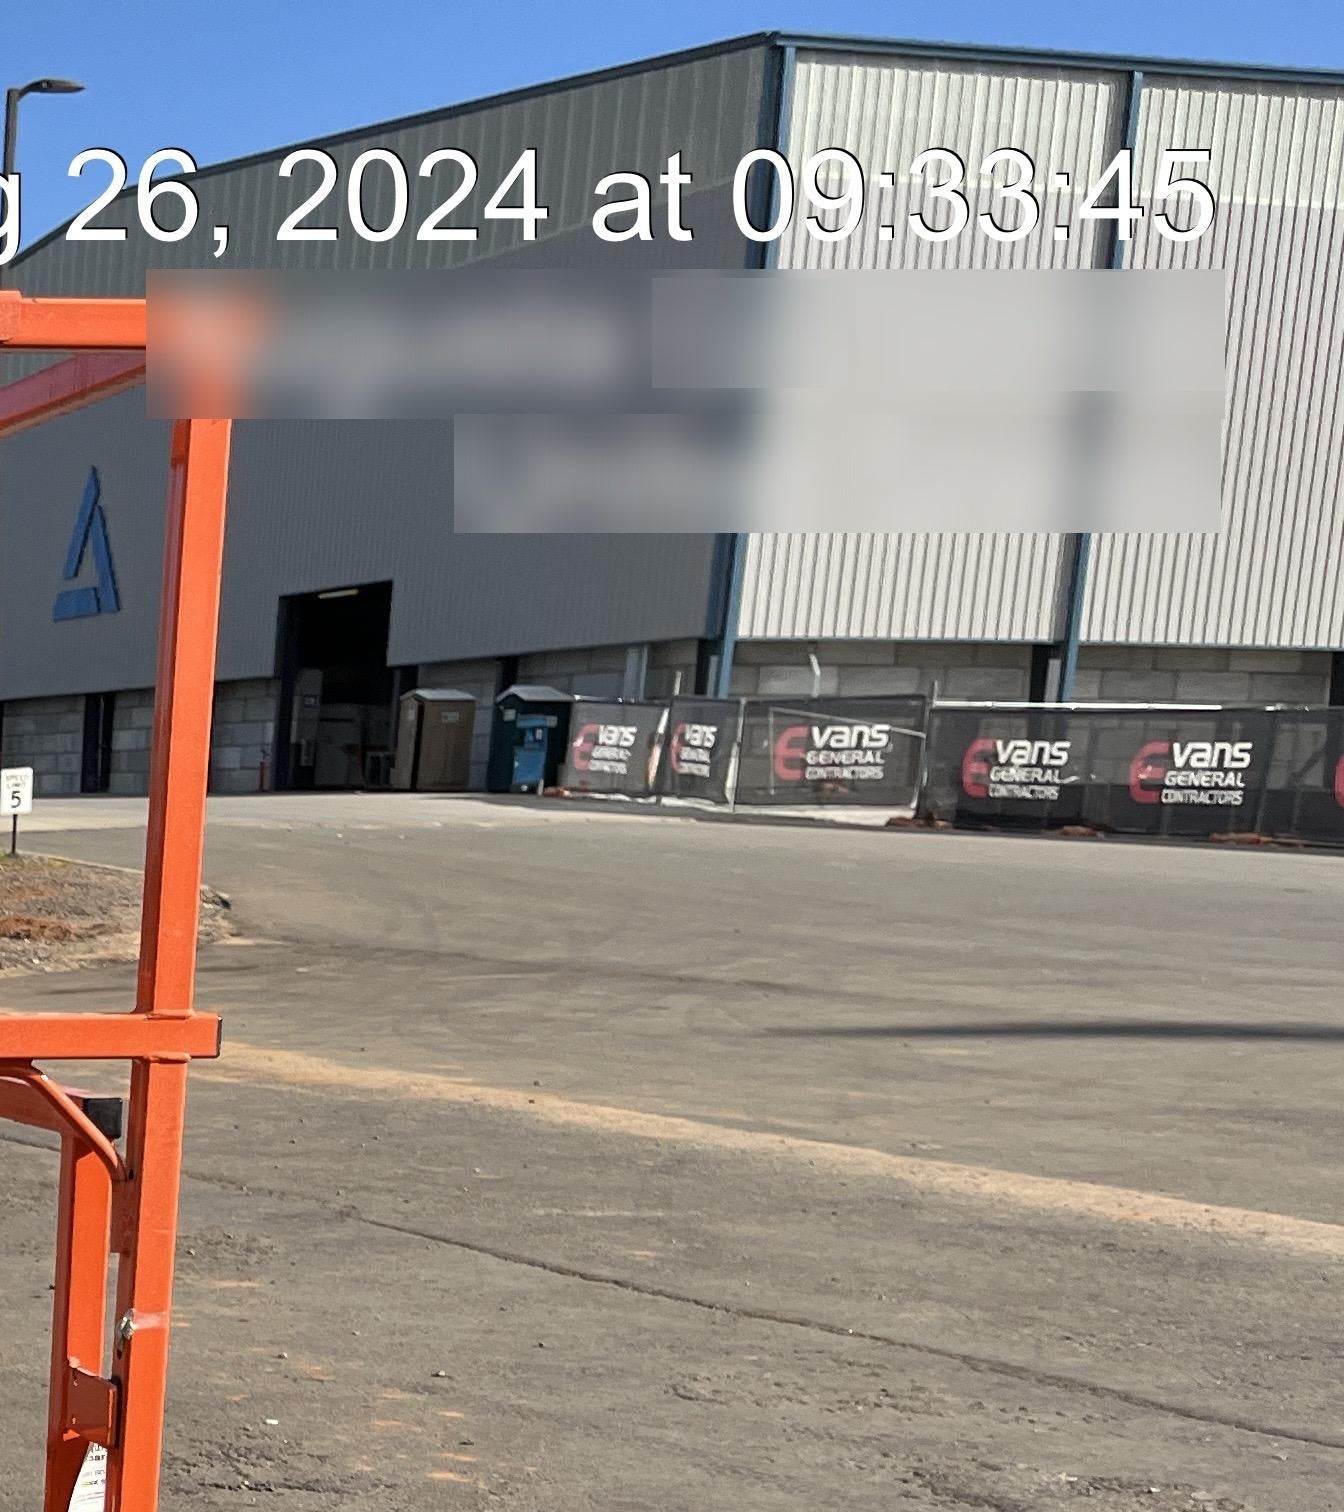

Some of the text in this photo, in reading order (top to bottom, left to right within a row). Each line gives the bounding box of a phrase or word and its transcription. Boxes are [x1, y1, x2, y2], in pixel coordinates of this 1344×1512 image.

[806, 749, 885, 765] GENERAL
[990, 765, 1061, 784] GENERAL
[1164, 770, 1245, 788] GENERAL
[11, 790, 21, 808] 5
